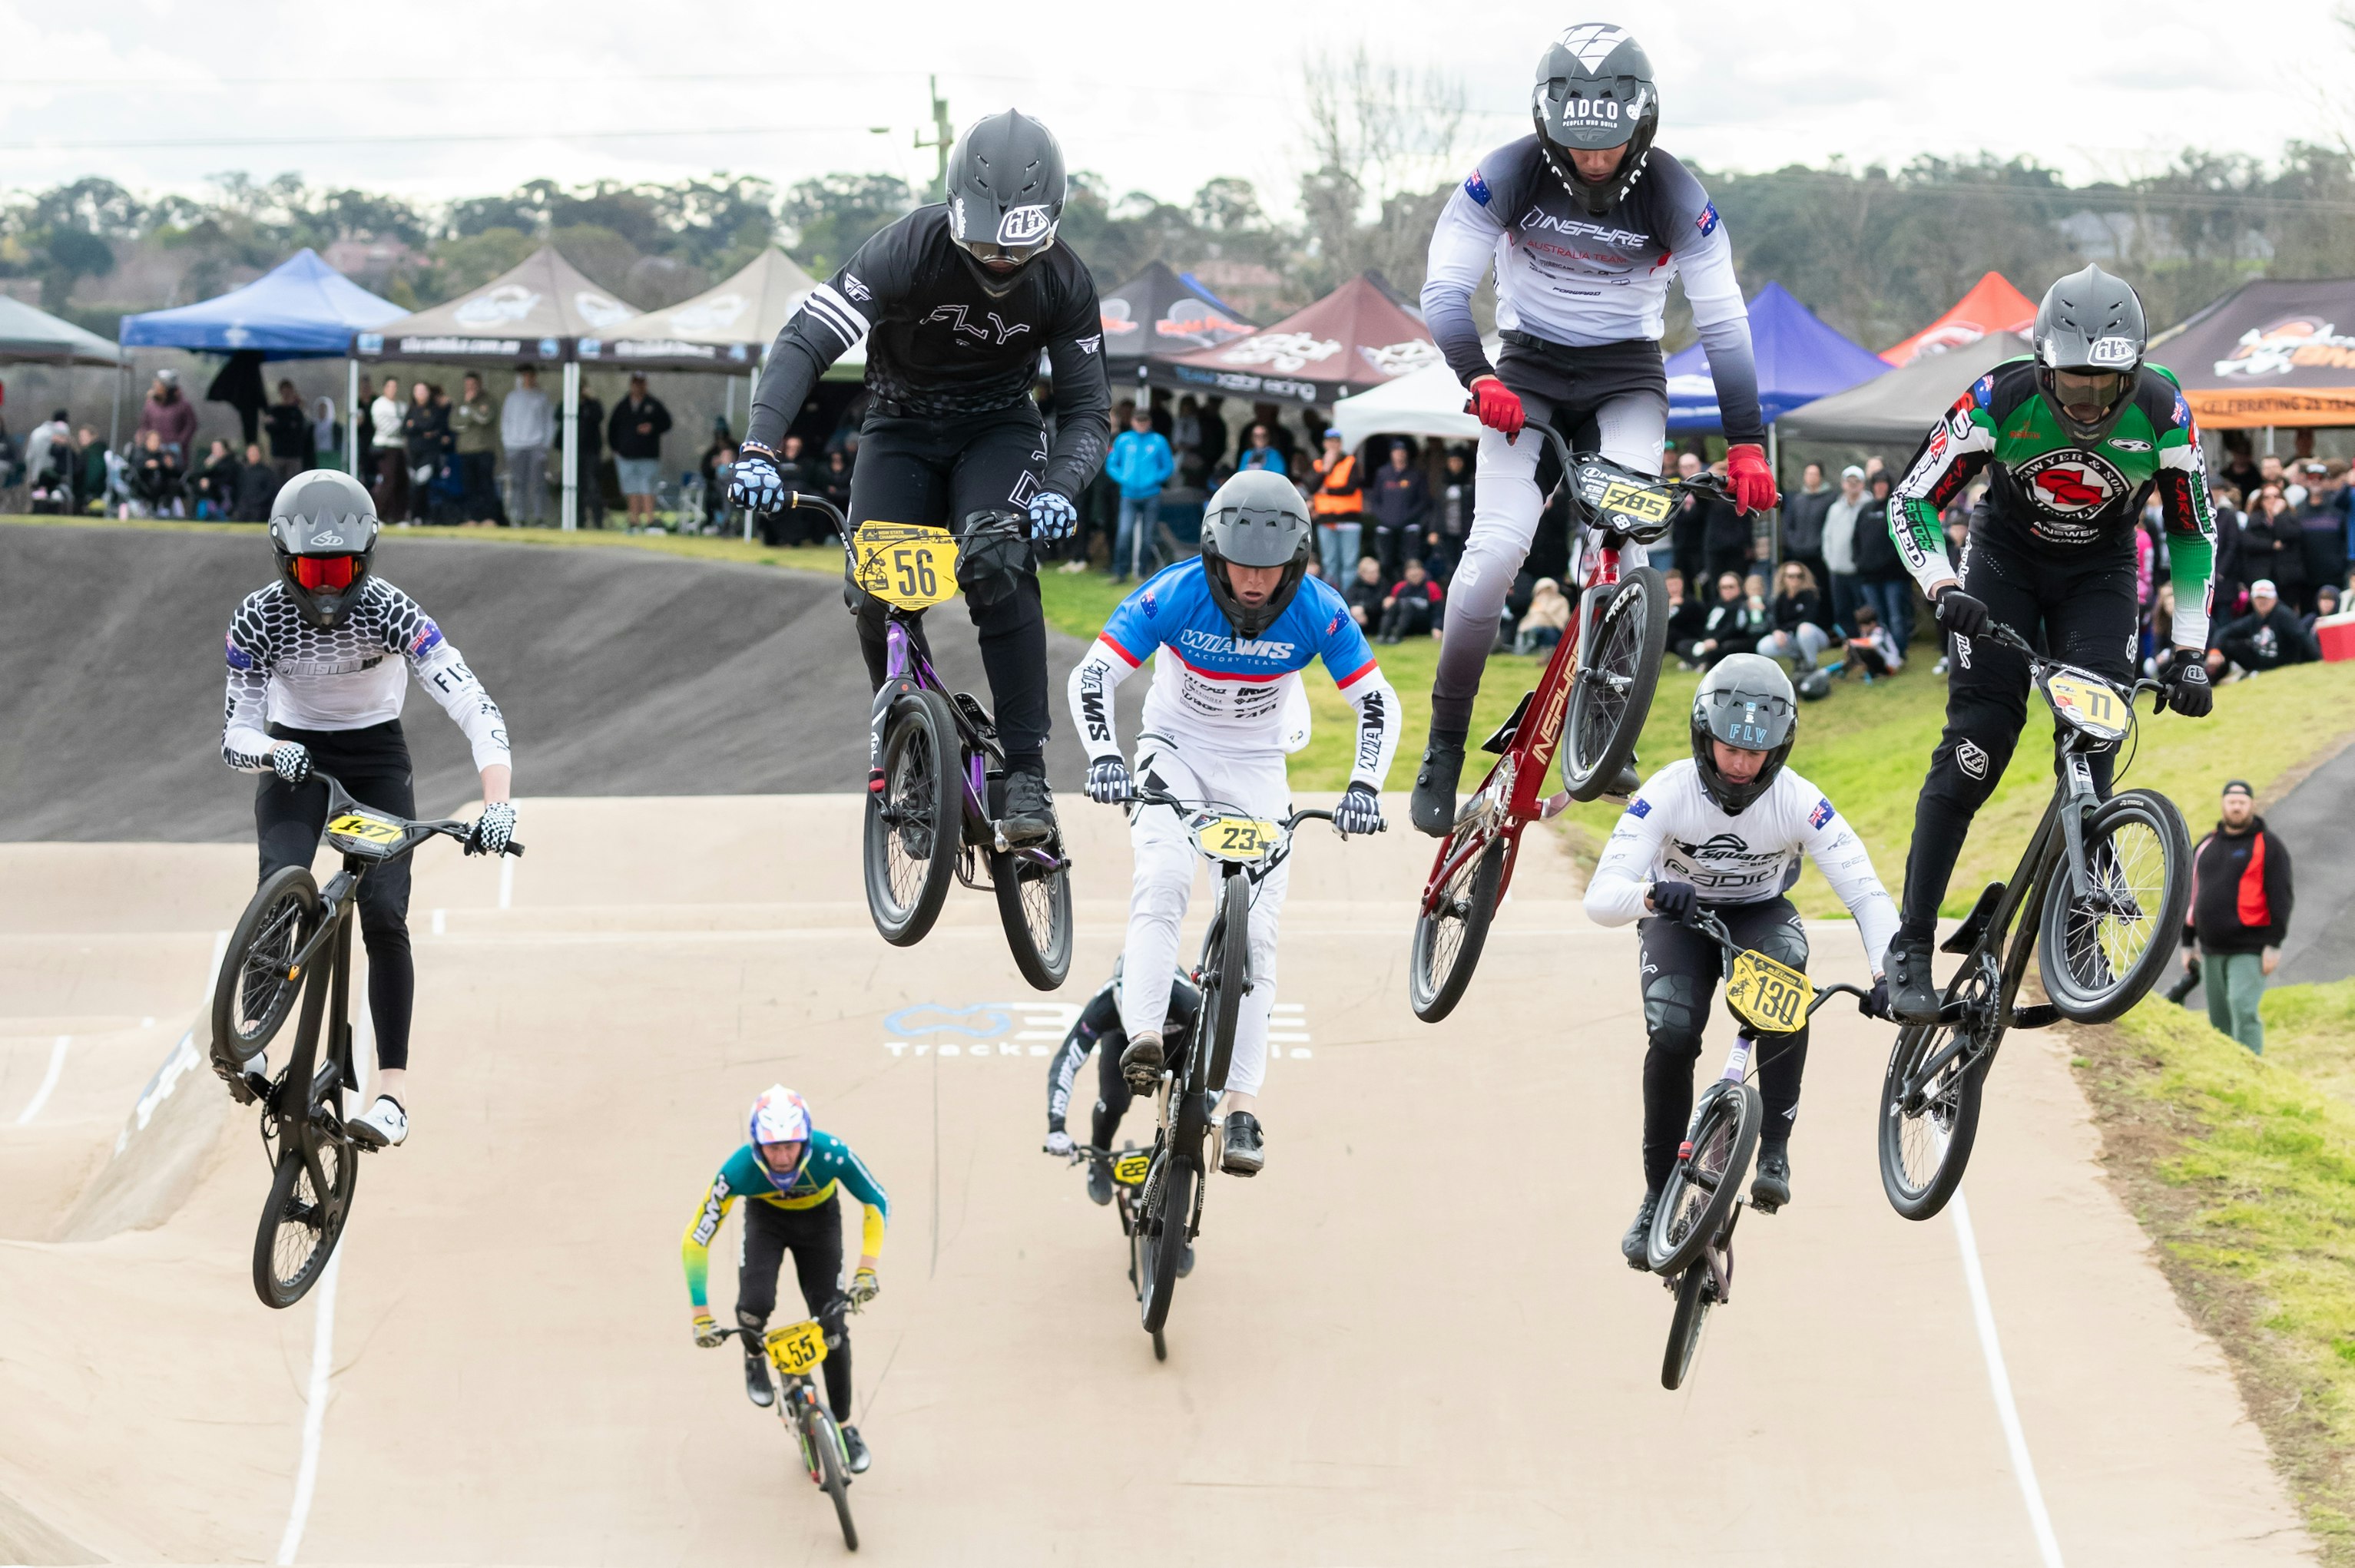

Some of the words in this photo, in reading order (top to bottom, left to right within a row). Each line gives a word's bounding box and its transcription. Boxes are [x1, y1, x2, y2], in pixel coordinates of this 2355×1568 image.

[1563, 99, 1618, 120] ADCO
[1562, 119, 1584, 127] PEOPLE
[1600, 121, 1618, 129] BUILD
[1539, 215, 1650, 247] INSPYRE
[1526, 240, 1591, 261] AUSTRALIA
[1594, 253, 1628, 264] TEAM
[1552, 286, 1601, 296] FORWARD
[1607, 488, 1664, 516] 585
[2033, 521, 2100, 538] ANSWER
[893, 548, 937, 597] 56
[1181, 629, 1296, 660] WIAWIS
[1187, 649, 1241, 663] FACTORY
[2085, 689, 2112, 720] 77
[1729, 723, 1767, 743] FLY
[338, 819, 395, 838] 147
[1221, 827, 1257, 851] 23
[1752, 974, 1801, 1027] 130
[883, 1041, 1050, 1058] Tracks
[787, 1333, 817, 1368] 55
